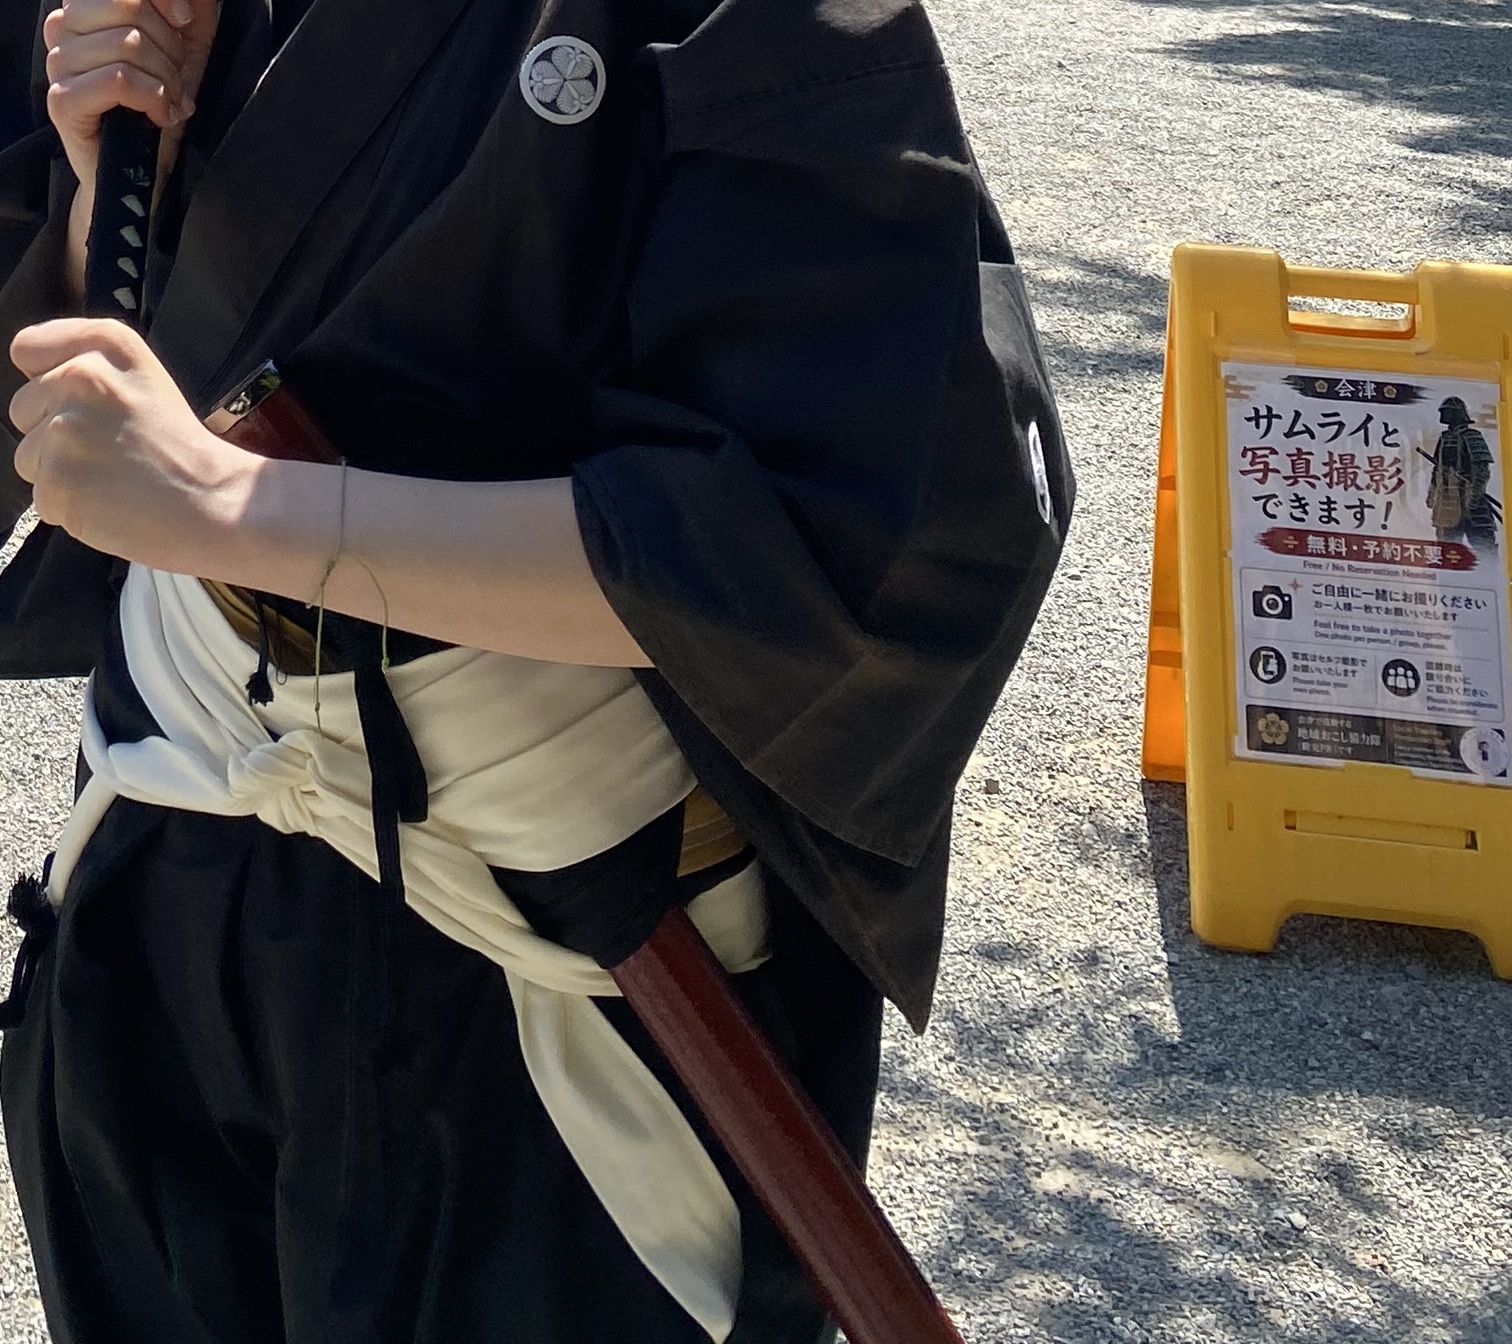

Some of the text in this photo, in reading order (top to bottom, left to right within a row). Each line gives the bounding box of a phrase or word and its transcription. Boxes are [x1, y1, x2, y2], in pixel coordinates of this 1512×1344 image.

[1334, 378, 1377, 399] 会津
[1243, 404, 1401, 448] サムライと
[1239, 445, 1405, 495] 写真撮影
[1252, 492, 1393, 530] できます！
[1306, 534, 1443, 565] 無料・予約不要
[1303, 560, 1323, 571] Free
[1332, 562, 1346, 573] No
[1347, 564, 1400, 578] Reservation
[1402, 568, 1437, 581] Needed
[1389, 625, 1414, 640] photo
